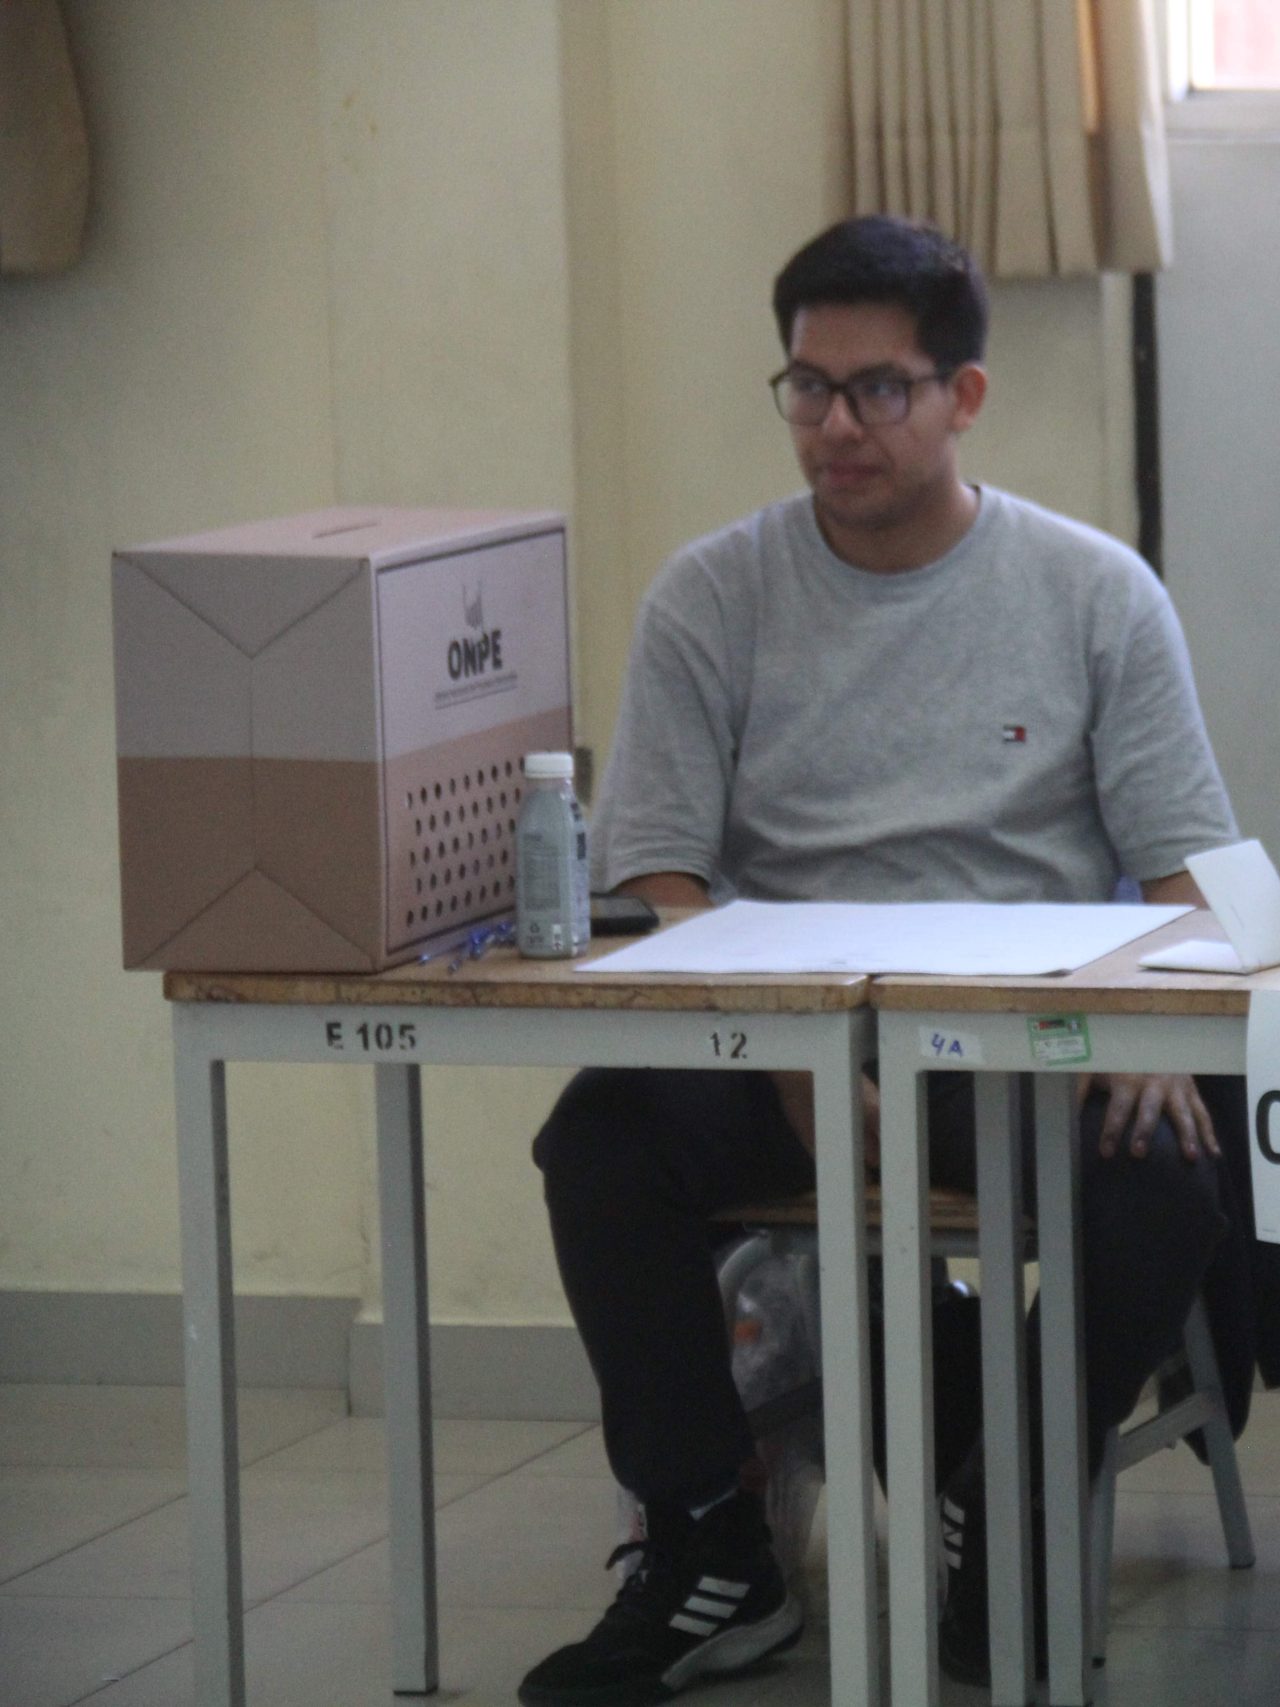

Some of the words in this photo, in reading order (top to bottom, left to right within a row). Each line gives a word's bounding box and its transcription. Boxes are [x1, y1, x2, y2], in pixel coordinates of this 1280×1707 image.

[447, 629, 503, 680] ONPE
[325, 1022, 343, 1050] E
[355, 1023, 417, 1052] 105
[709, 1031, 748, 1060] 12
